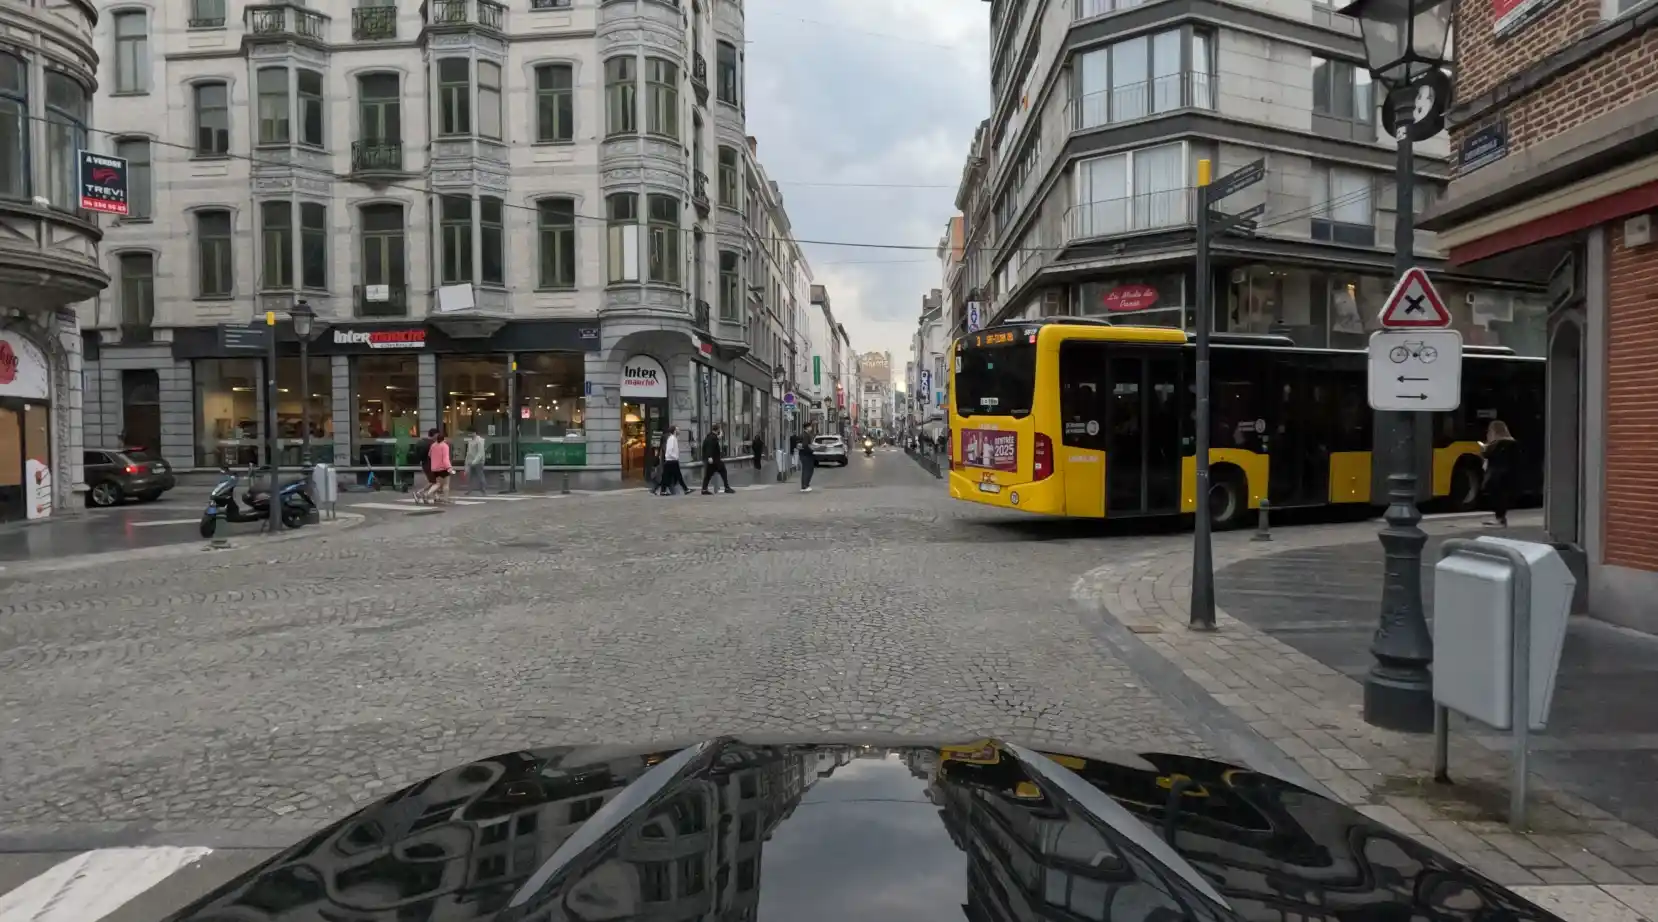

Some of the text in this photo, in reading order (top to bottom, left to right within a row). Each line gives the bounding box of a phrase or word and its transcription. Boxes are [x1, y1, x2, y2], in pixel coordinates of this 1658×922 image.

[85, 184, 124, 197] TREVI
[625, 366, 659, 384] Inter
[994, 444, 1015, 457] 2025
